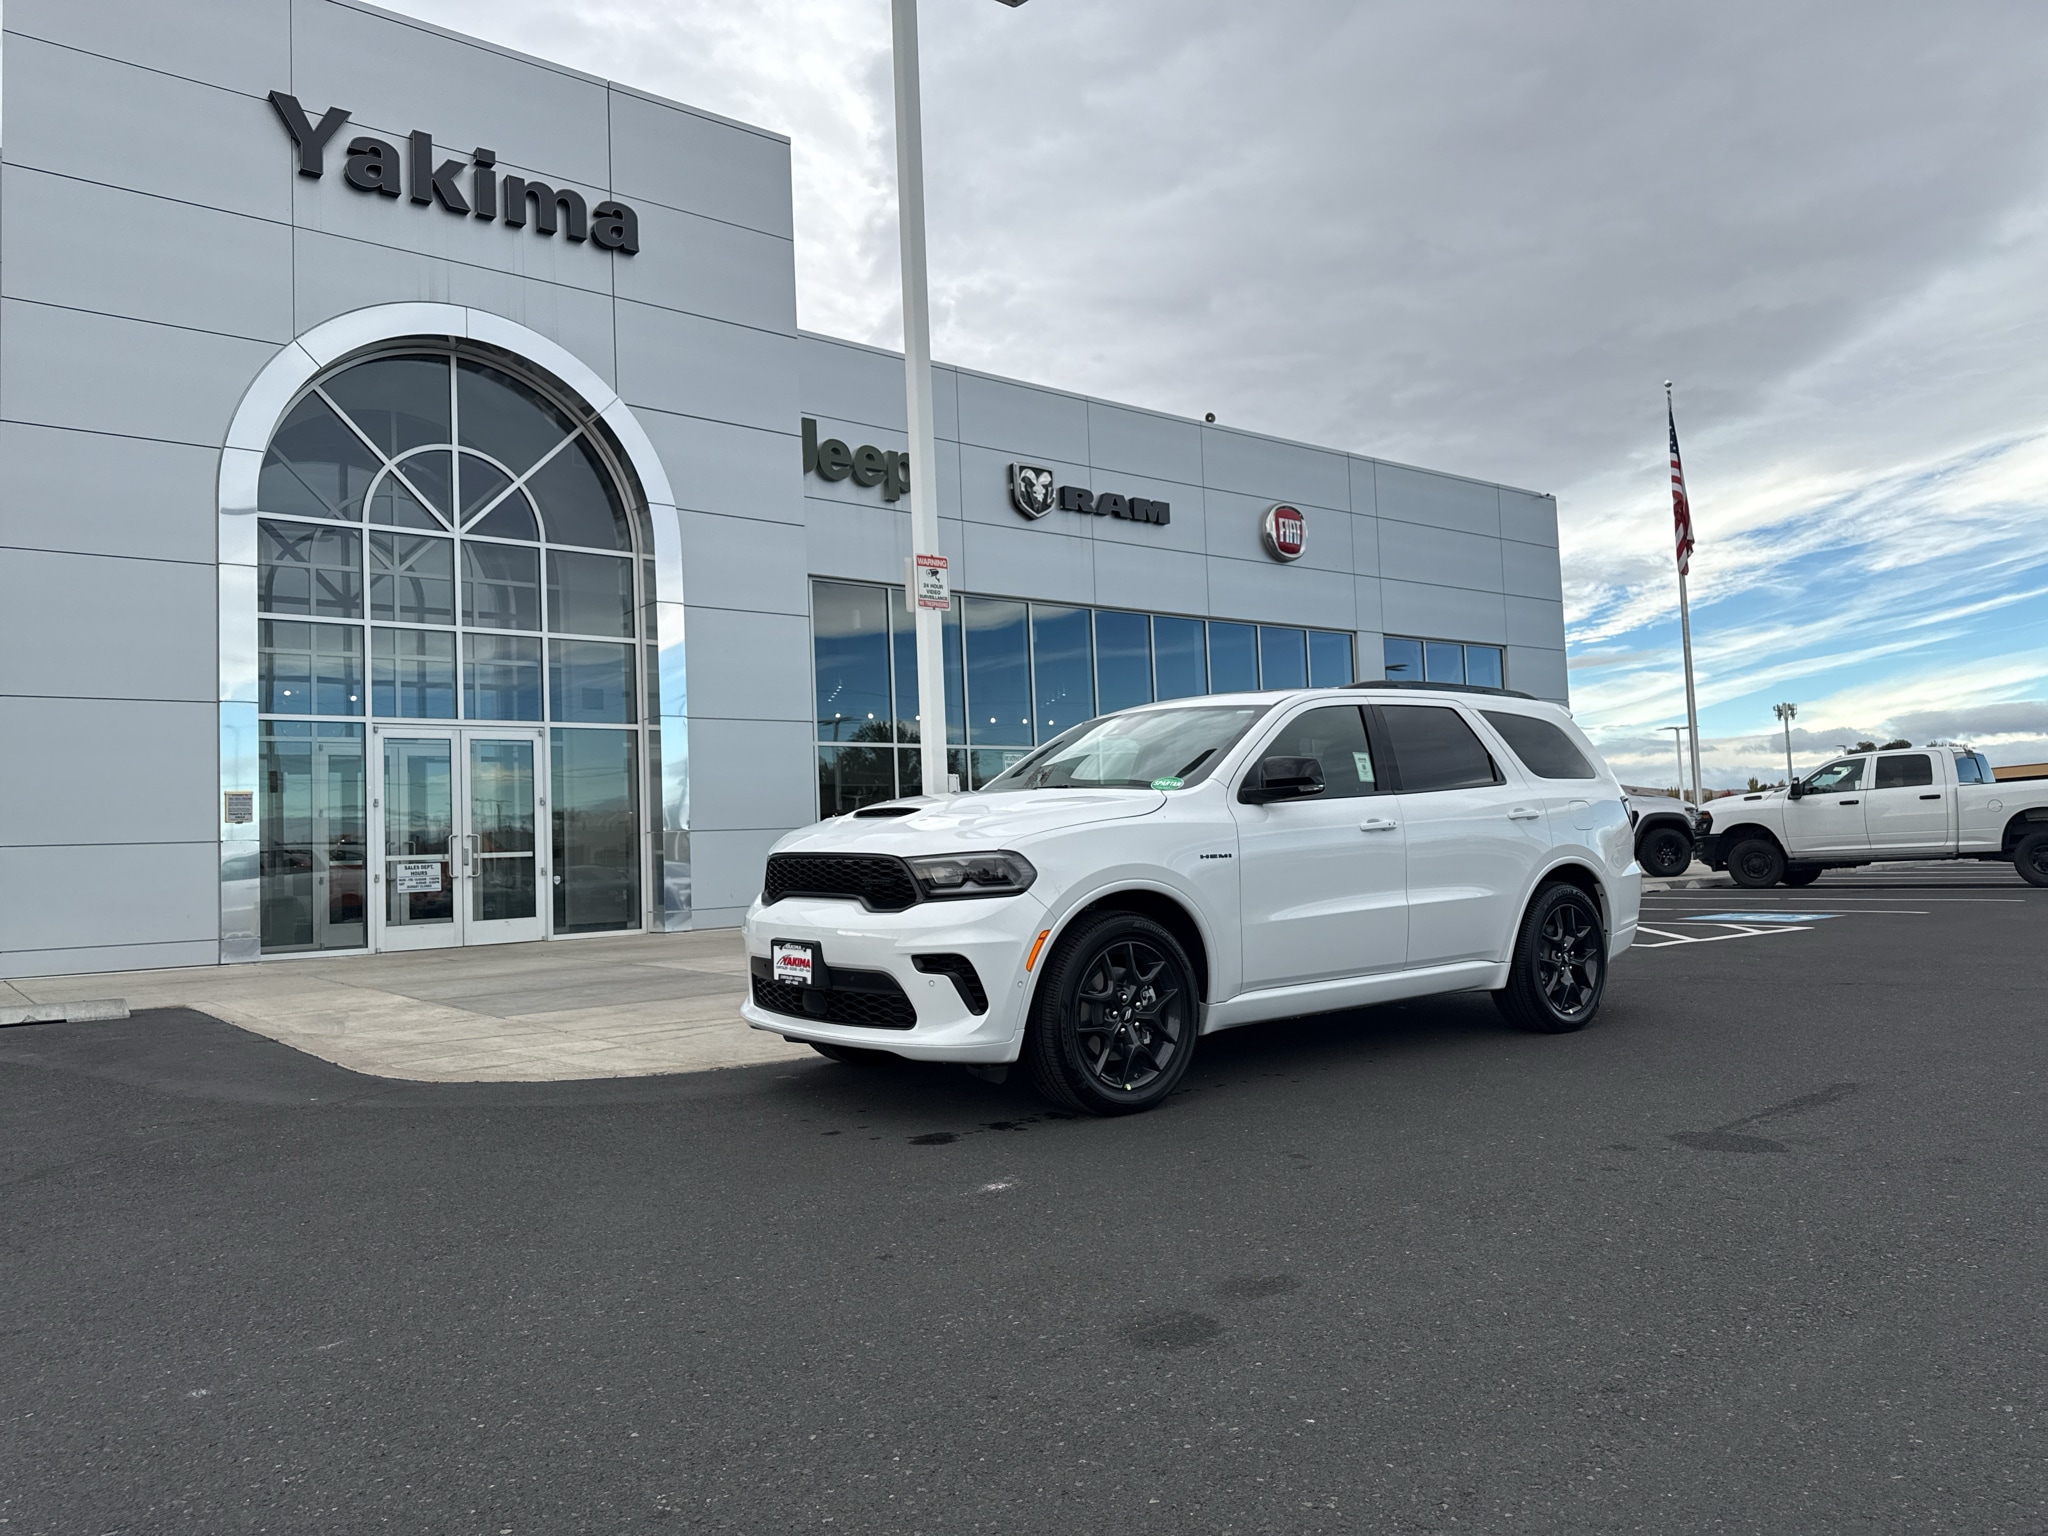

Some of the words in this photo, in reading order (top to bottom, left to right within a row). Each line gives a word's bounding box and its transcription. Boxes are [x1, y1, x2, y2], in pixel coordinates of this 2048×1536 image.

[268, 90, 640, 256] Yakima
[1057, 485, 1171, 526] RAM
[1278, 517, 1301, 545] FIAT
[917, 557, 947, 568] WARNING
[783, 956, 810, 968] YAKIMA
